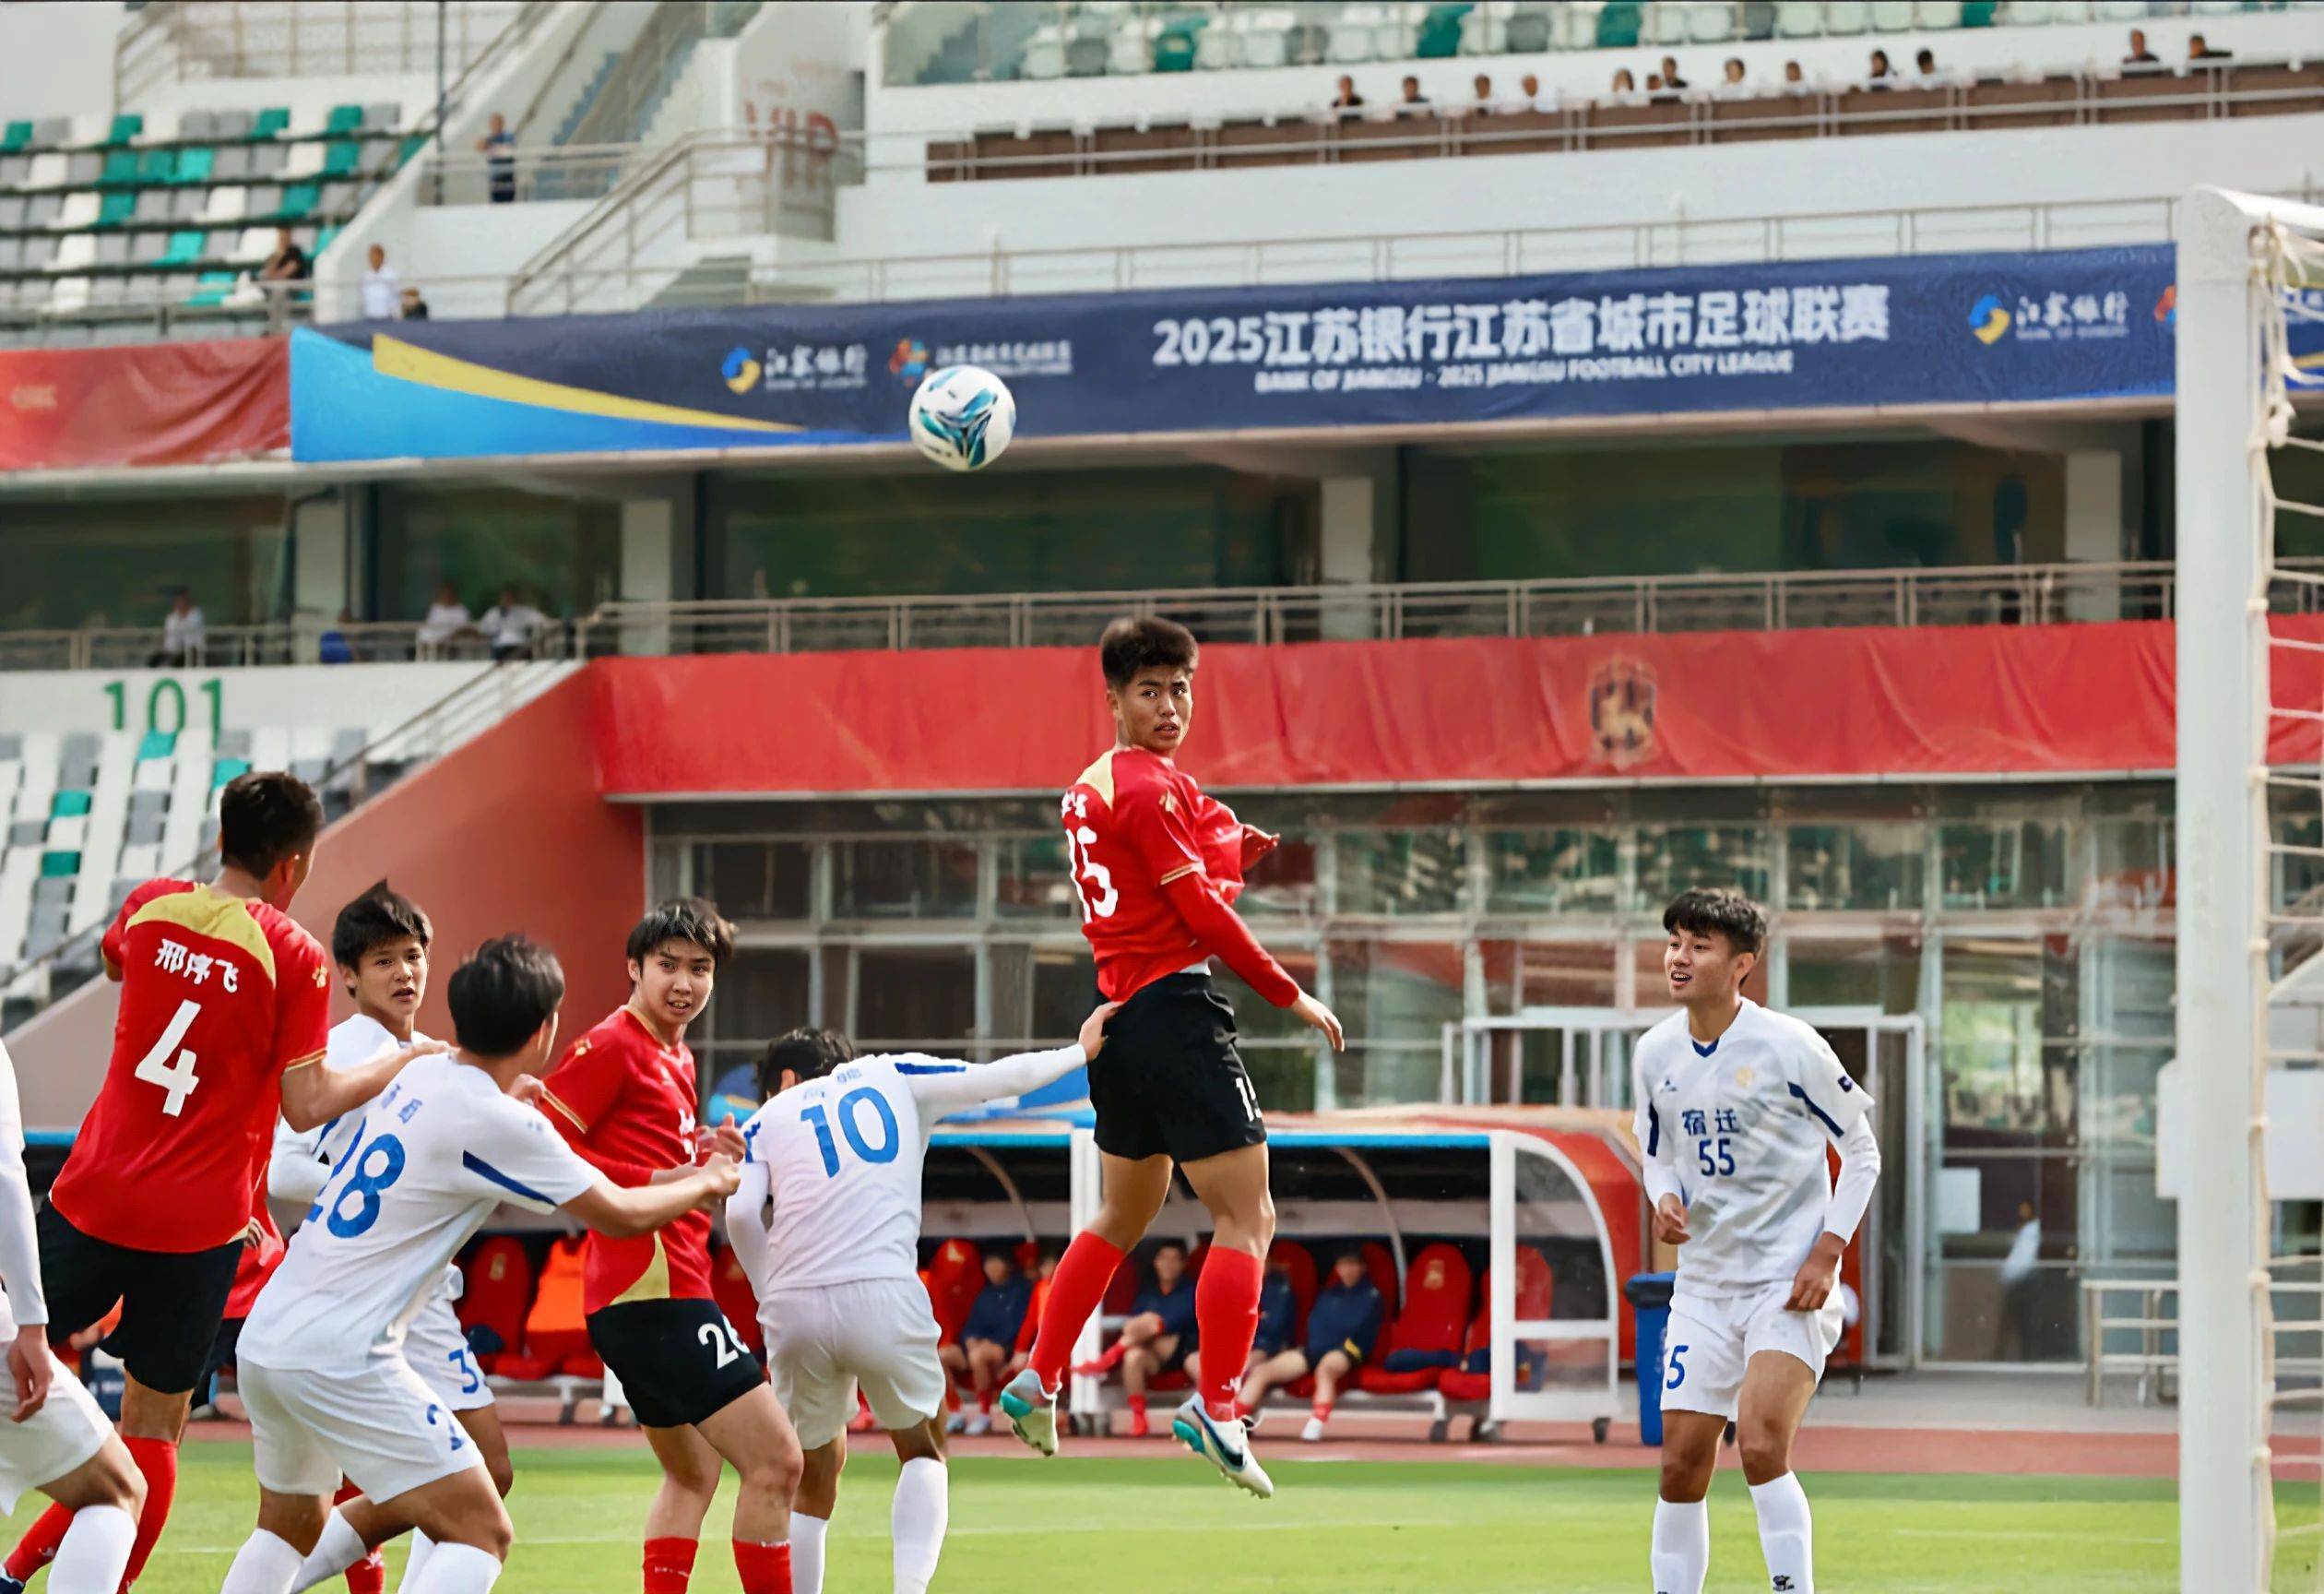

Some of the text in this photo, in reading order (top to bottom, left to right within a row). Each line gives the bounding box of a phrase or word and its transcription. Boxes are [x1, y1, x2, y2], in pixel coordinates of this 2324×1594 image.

[1152, 284, 1890, 367] 2025江苏银行江苏省城市足球联赛
[103, 677, 221, 752] 101
[135, 998, 202, 1118] 4
[800, 1086, 899, 1179] 10
[1698, 1138, 1736, 1176] 55
